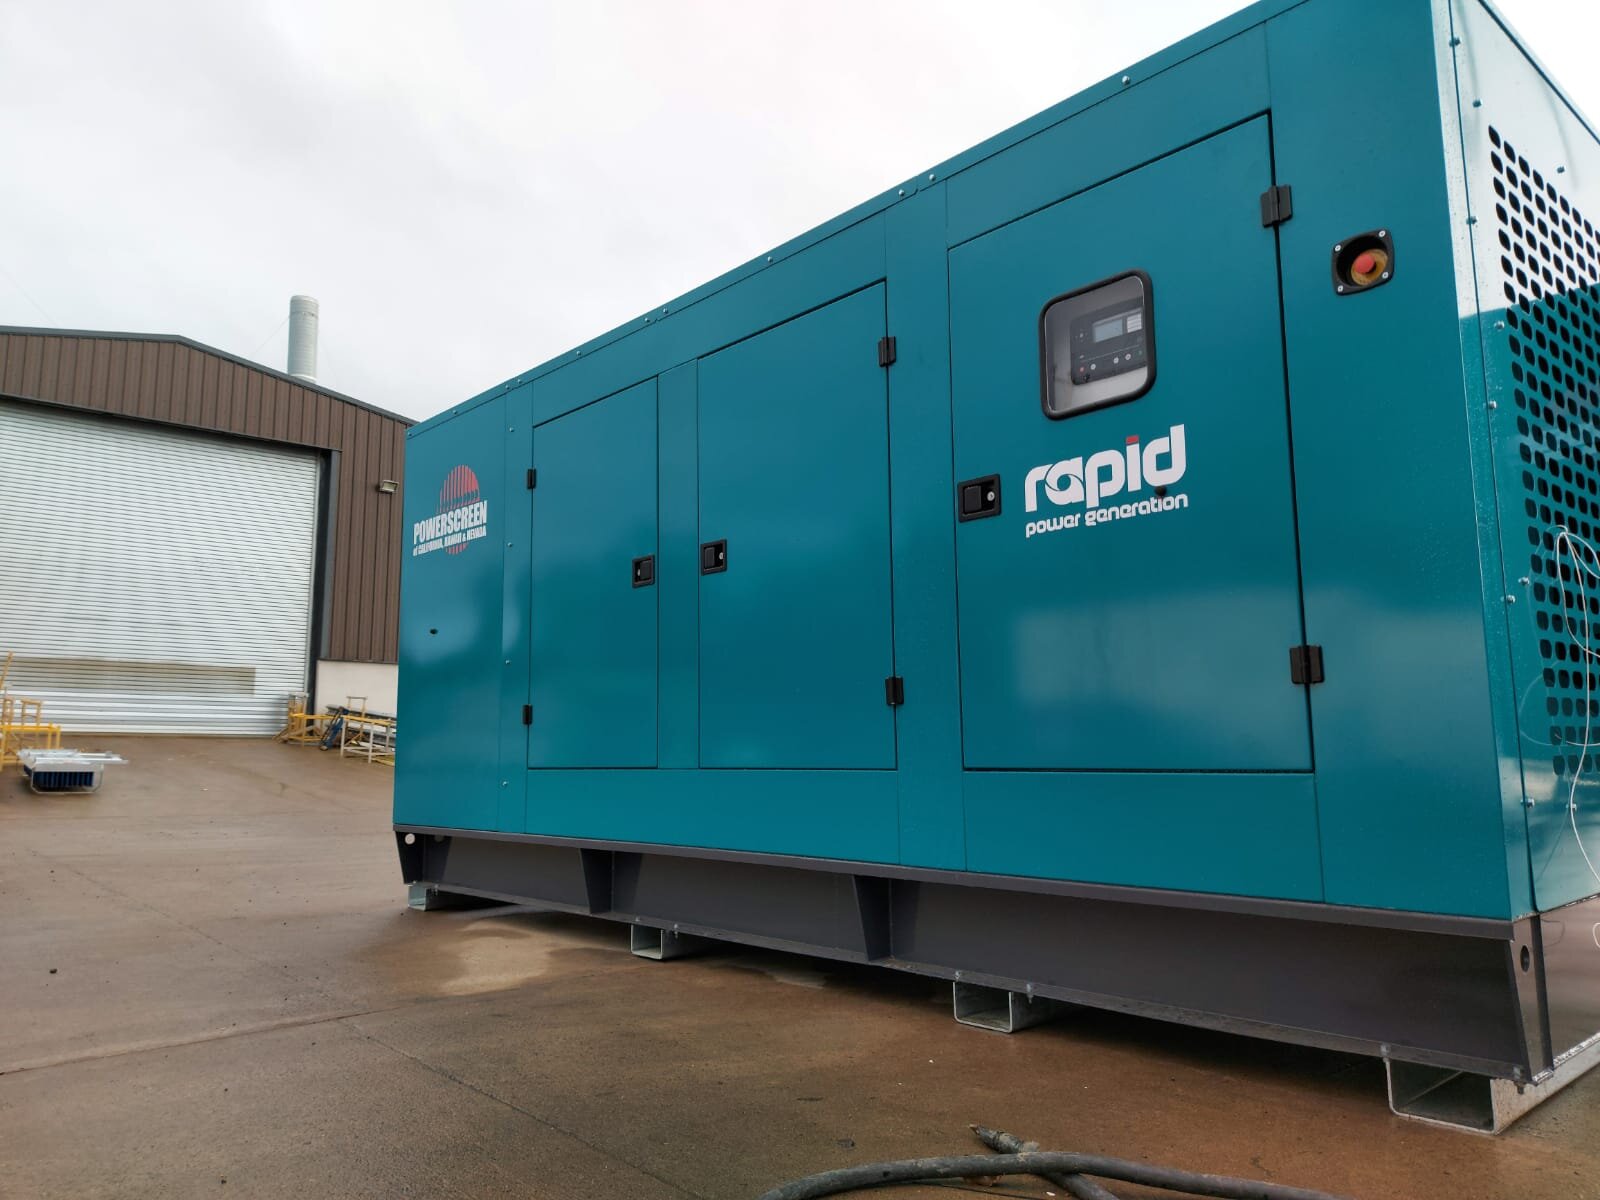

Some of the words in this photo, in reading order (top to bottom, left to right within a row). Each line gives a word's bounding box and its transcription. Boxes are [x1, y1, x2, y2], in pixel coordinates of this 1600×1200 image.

[1025, 424, 1187, 512] rapid
[413, 500, 488, 545] POWERSCREEN
[1025, 513, 1081, 538] power
[1085, 493, 1189, 526] generation
